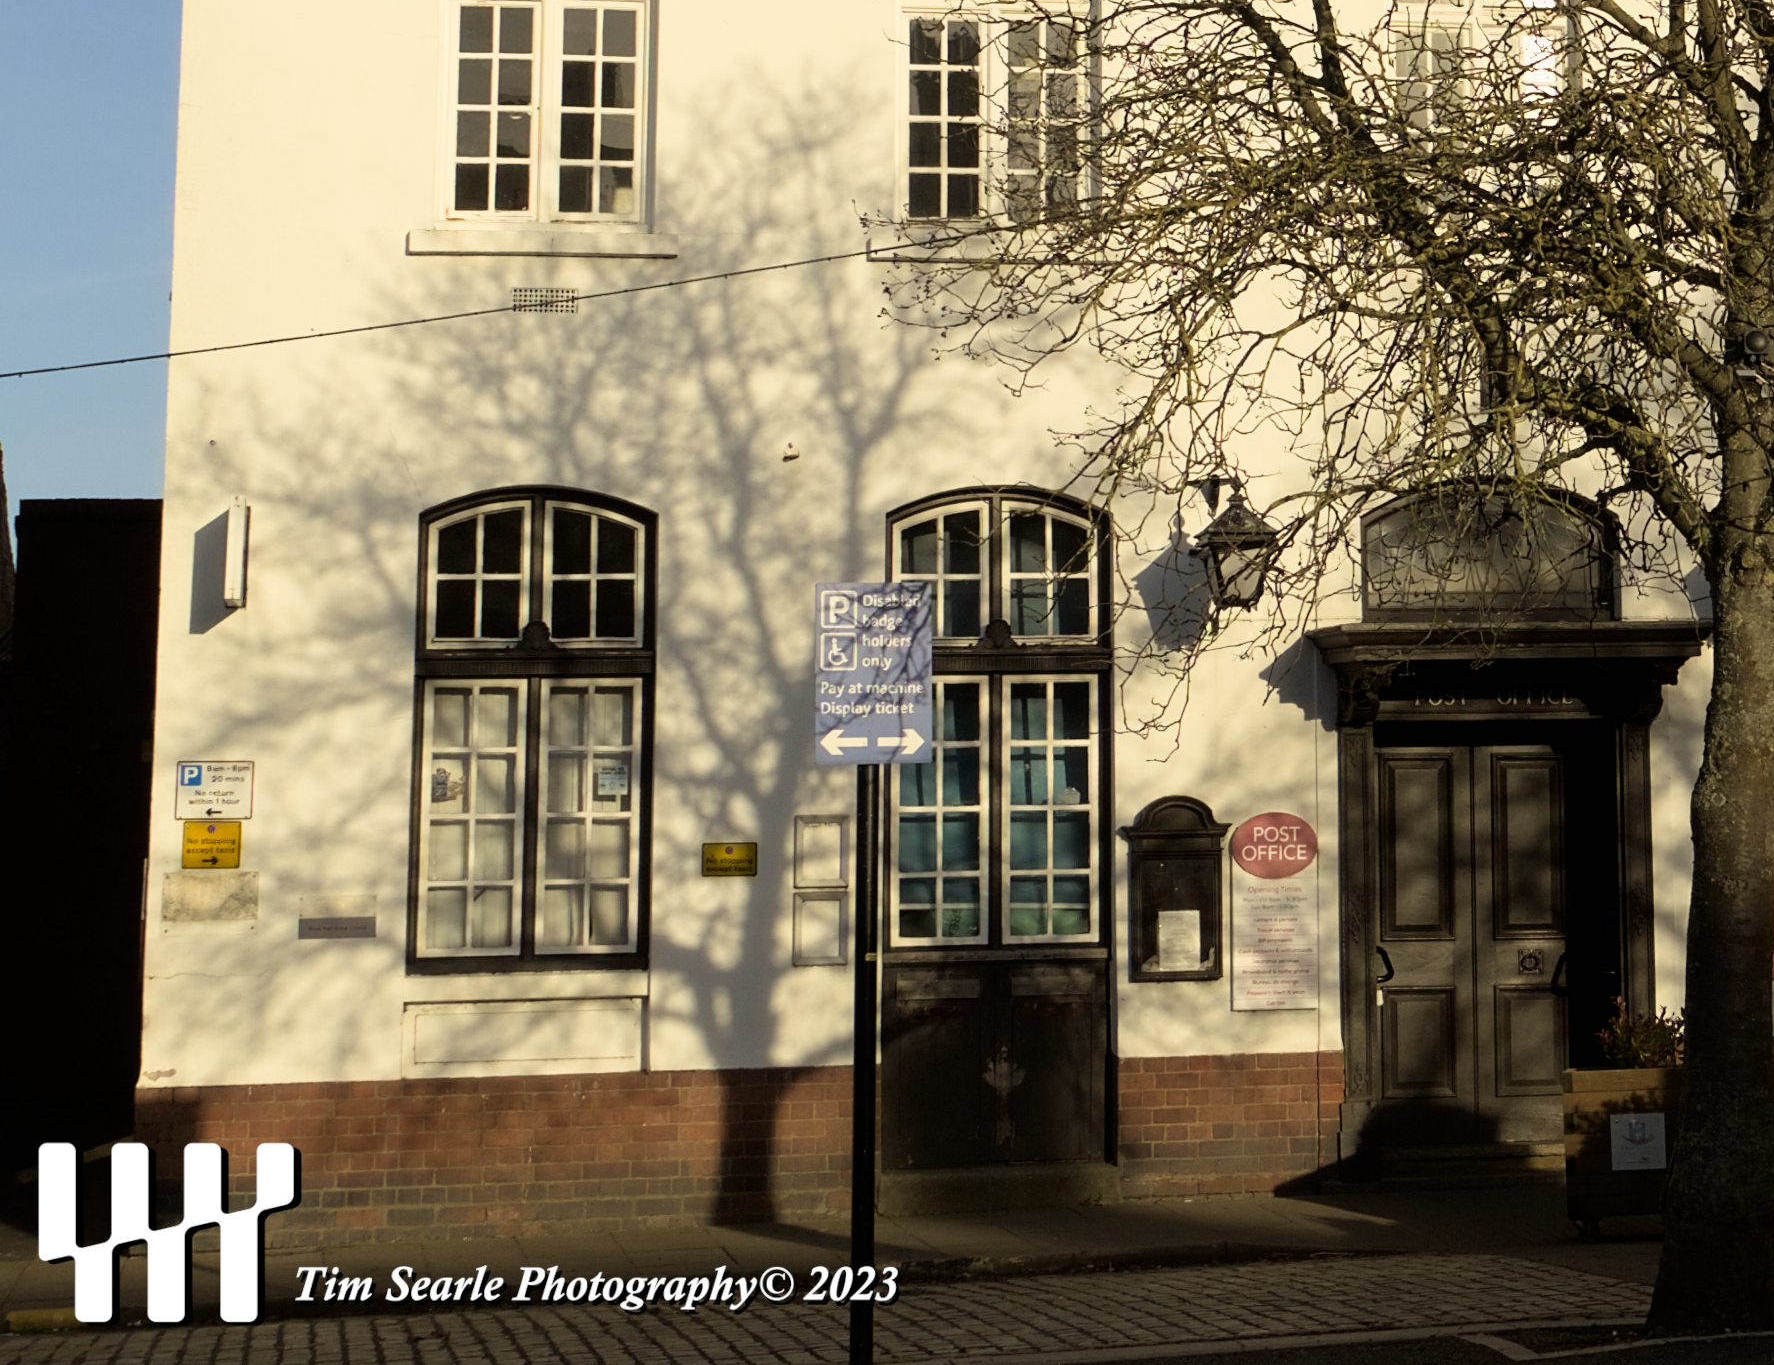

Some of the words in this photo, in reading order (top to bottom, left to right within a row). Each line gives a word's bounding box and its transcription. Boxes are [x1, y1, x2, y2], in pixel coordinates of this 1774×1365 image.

[862, 594, 921, 607] Disabled
[862, 614, 903, 631] badge
[862, 634, 912, 647] holders
[862, 656, 892, 670] only
[820, 681, 845, 697] Pay
[848, 682, 863, 694] at
[866, 682, 924, 694] machine
[1415, 689, 1469, 706] POST
[1497, 689, 1573, 705] OFFICE
[820, 701, 872, 717] Display
[875, 701, 915, 715] ticket
[184, 767, 199, 785] P
[208, 789, 235, 797] return
[1253, 826, 1301, 842] POST
[1242, 844, 1307, 861] OFFICE
[1247, 886, 1279, 894] Opening
